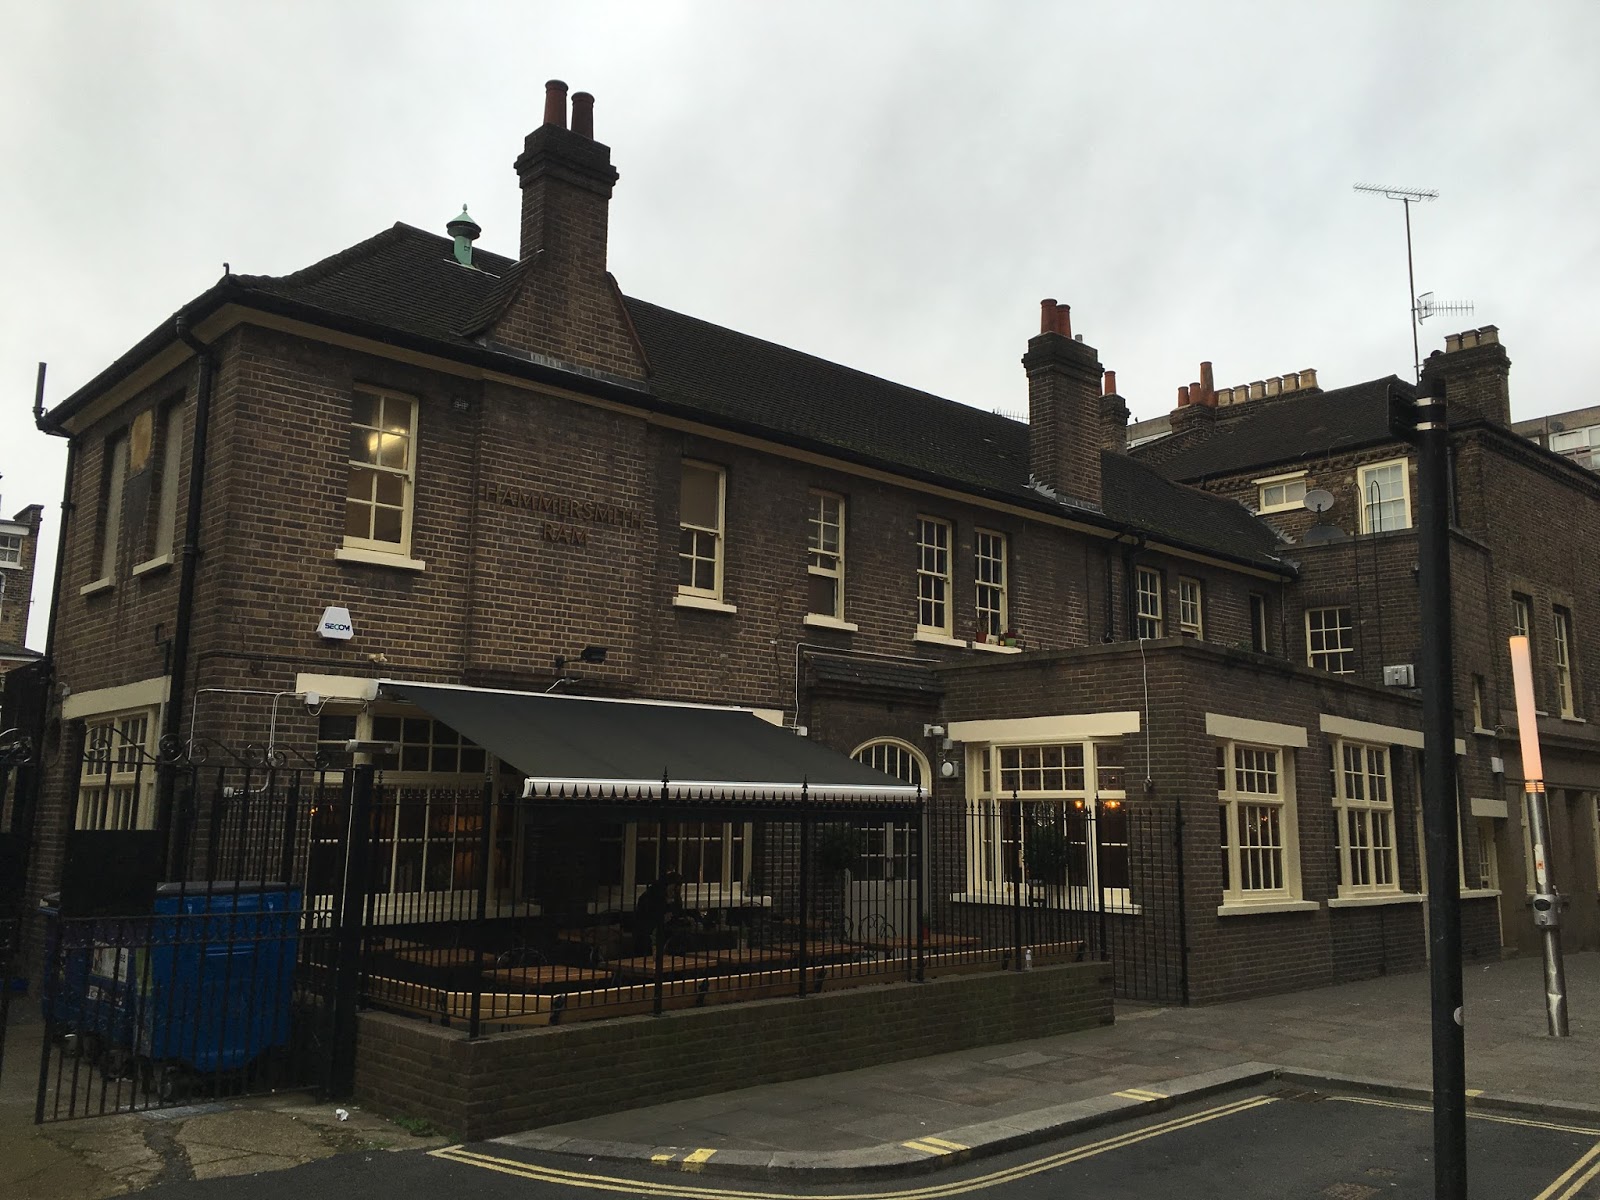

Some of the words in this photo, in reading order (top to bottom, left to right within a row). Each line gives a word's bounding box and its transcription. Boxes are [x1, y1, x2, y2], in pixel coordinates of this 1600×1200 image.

[484, 483, 644, 530] HAMMERSMITH
[543, 521, 588, 546] RAM
[324, 622, 351, 631] SECOM
